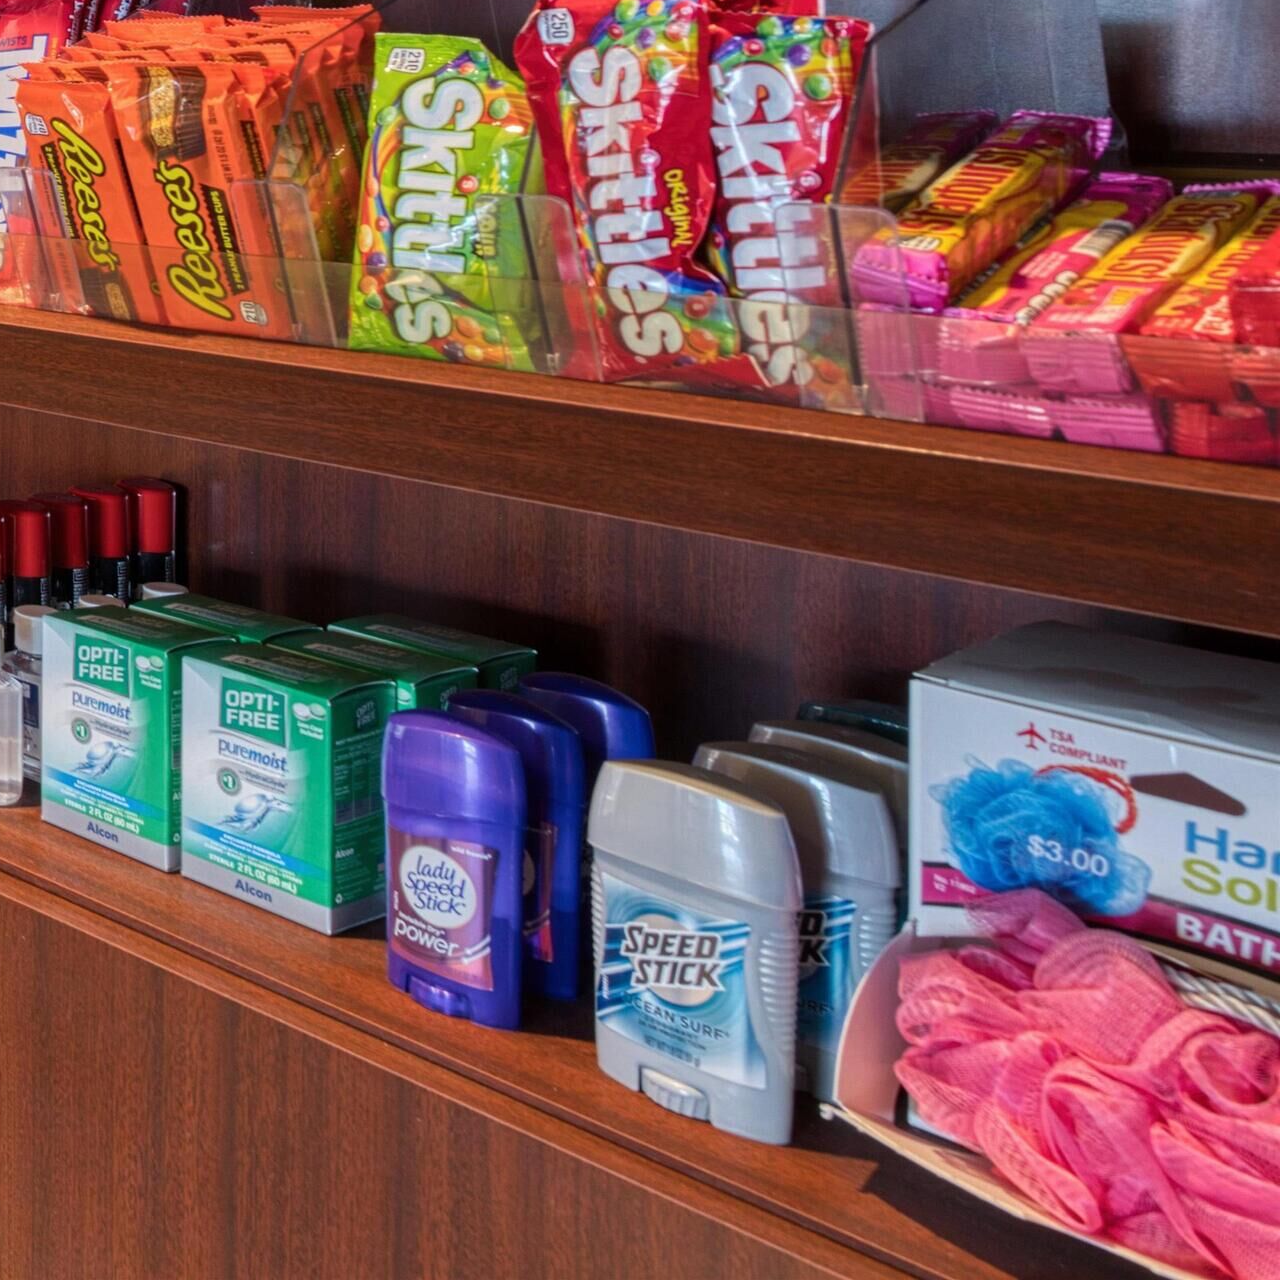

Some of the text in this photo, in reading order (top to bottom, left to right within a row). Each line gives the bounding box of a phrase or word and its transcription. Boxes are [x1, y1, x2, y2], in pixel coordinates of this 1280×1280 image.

[51, 118, 116, 272] Reese's
[385, 77, 484, 344] Skittles
[568, 46, 686, 357] Skittles
[710, 62, 826, 387] Skittles
[156, 160, 235, 321] Reese's
[77, 644, 125, 663] OPTI-
[78, 663, 125, 683] FREE
[71, 690, 131, 721] puremoist
[225, 689, 280, 712] OPTI-
[225, 710, 280, 731] FREE
[1049, 727, 1076, 744] TSA
[218, 739, 288, 772] puremoist
[1048, 741, 1129, 771] COMPLIANT
[86, 821, 120, 843] Alcon
[416, 855, 456, 886] lady
[1027, 833, 1110, 877] $3.00
[234, 878, 273, 903] Alcon
[404, 871, 466, 900] Speed
[413, 891, 467, 917] Stick
[393, 917, 460, 957] power
[622, 923, 721, 961] SPEED
[1175, 911, 1280, 968] BATH
[634, 958, 723, 989] STICK
